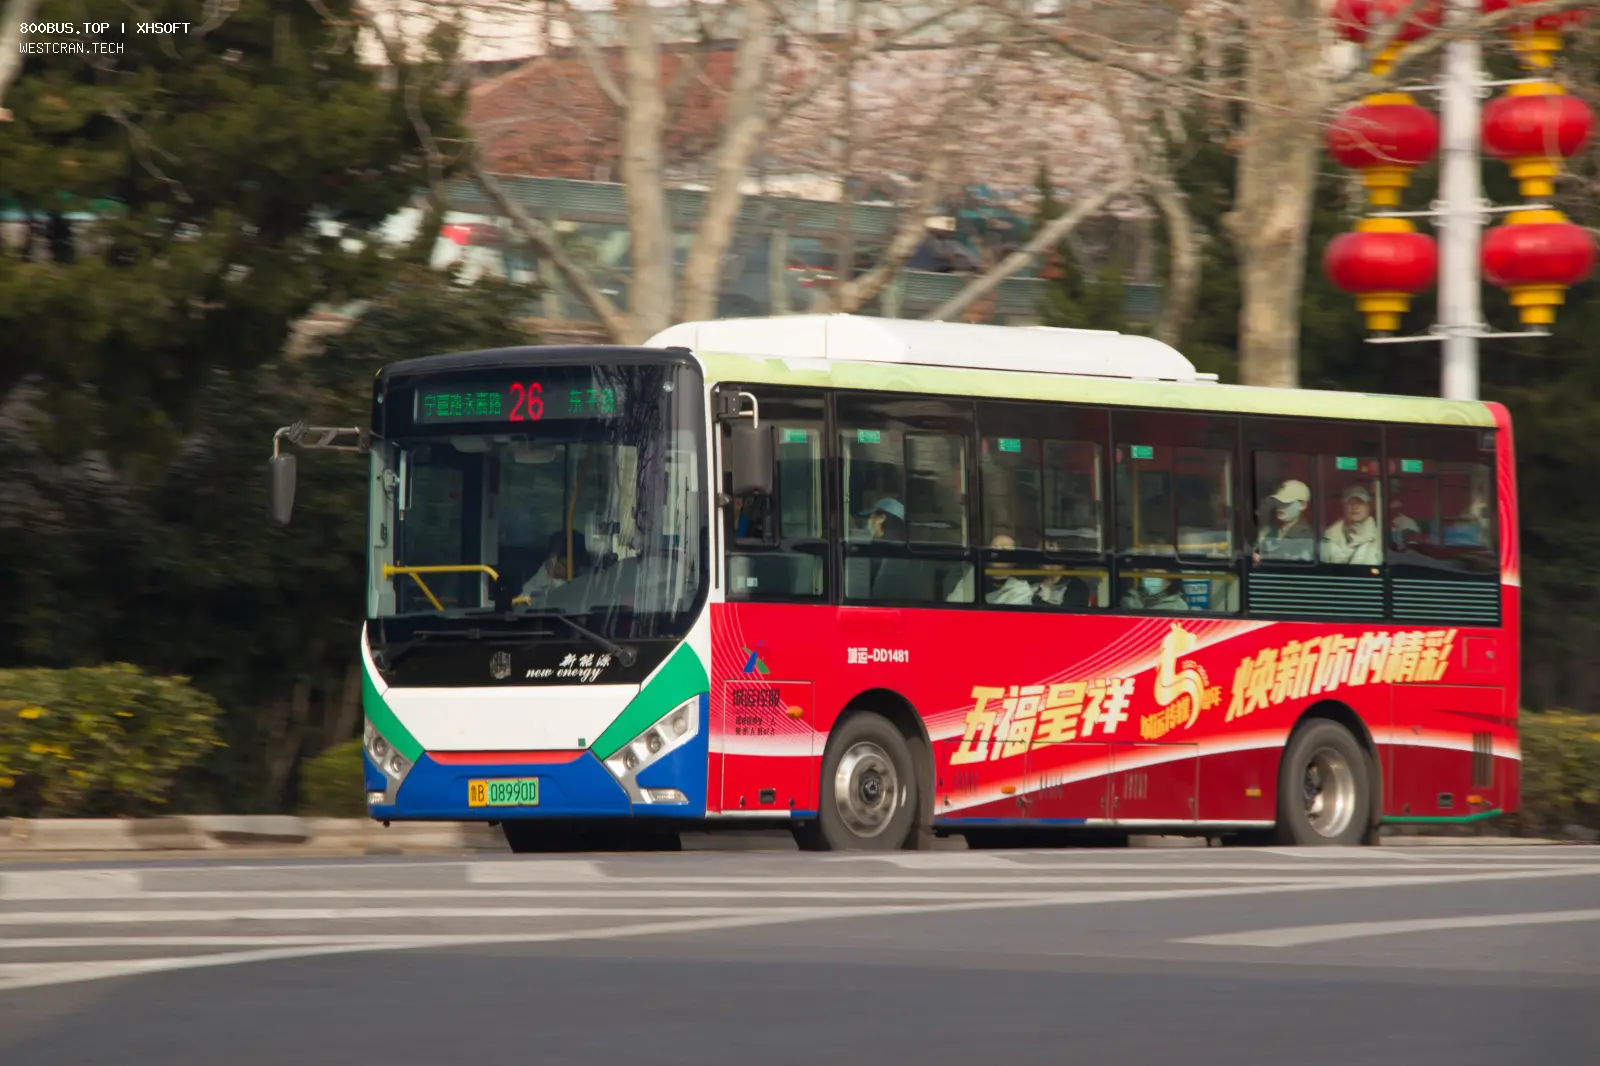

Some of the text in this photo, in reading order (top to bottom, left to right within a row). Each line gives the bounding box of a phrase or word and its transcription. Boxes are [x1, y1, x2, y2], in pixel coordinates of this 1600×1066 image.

[509, 382, 544, 422] 26
[525, 666, 602, 682] new energy
[559, 653, 612, 668] 新能源
[1224, 629, 1458, 722] 焕新你的精彩
[950, 677, 1136, 765] 五福呈祥
